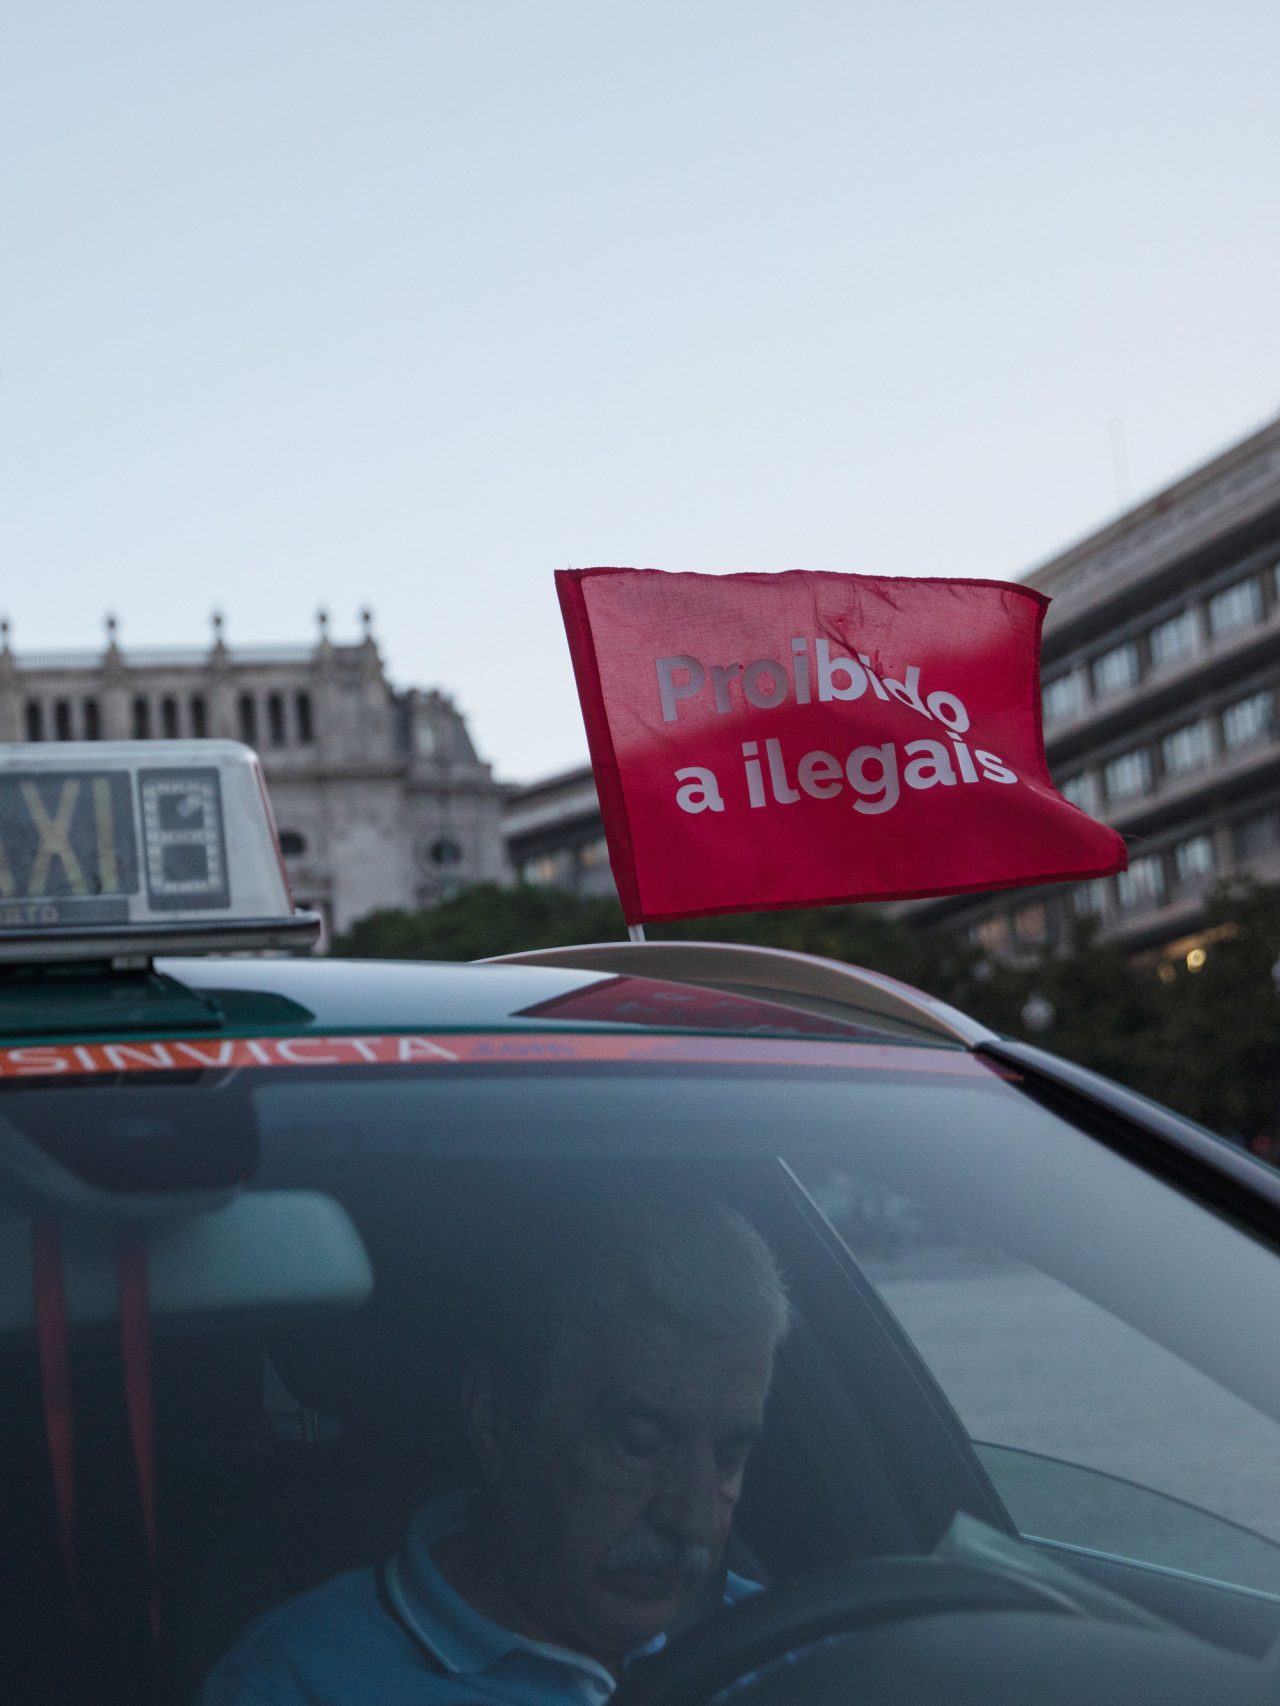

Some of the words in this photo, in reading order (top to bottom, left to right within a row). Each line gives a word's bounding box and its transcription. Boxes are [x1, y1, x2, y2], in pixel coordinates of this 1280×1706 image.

[655, 636, 970, 734] Proibido
[673, 766, 725, 814] a
[741, 730, 1018, 816] ilegais
